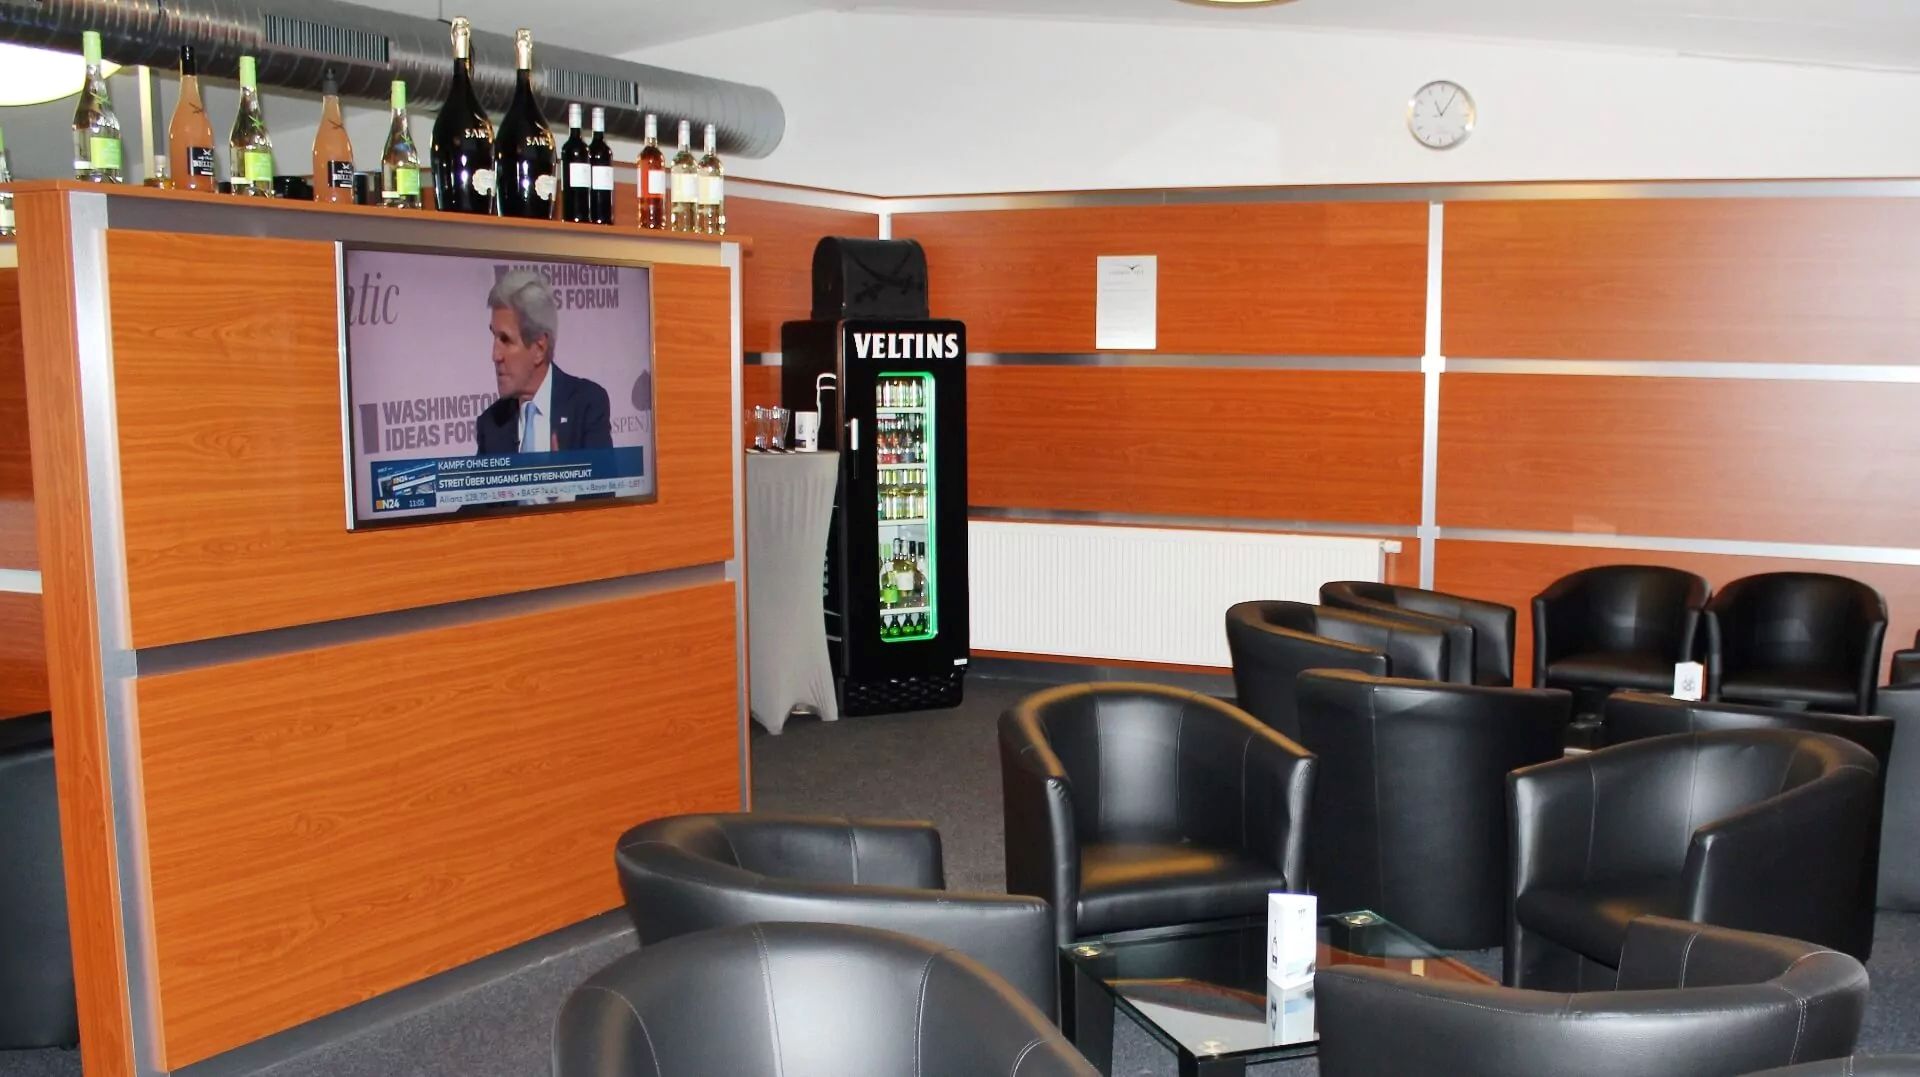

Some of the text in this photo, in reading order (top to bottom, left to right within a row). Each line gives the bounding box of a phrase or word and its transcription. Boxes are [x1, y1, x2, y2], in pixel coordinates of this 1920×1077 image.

[566, 288, 619, 309] FORUM
[853, 333, 959, 359] VELTINS
[385, 424, 440, 451] IDEAS
[438, 457, 511, 470] KAMPF OHNE ENDE
[439, 469, 592, 489] STREIT ÜBER UMGANG MIT SYRIEN-KONFLIKT
[382, 499, 400, 509] N24
